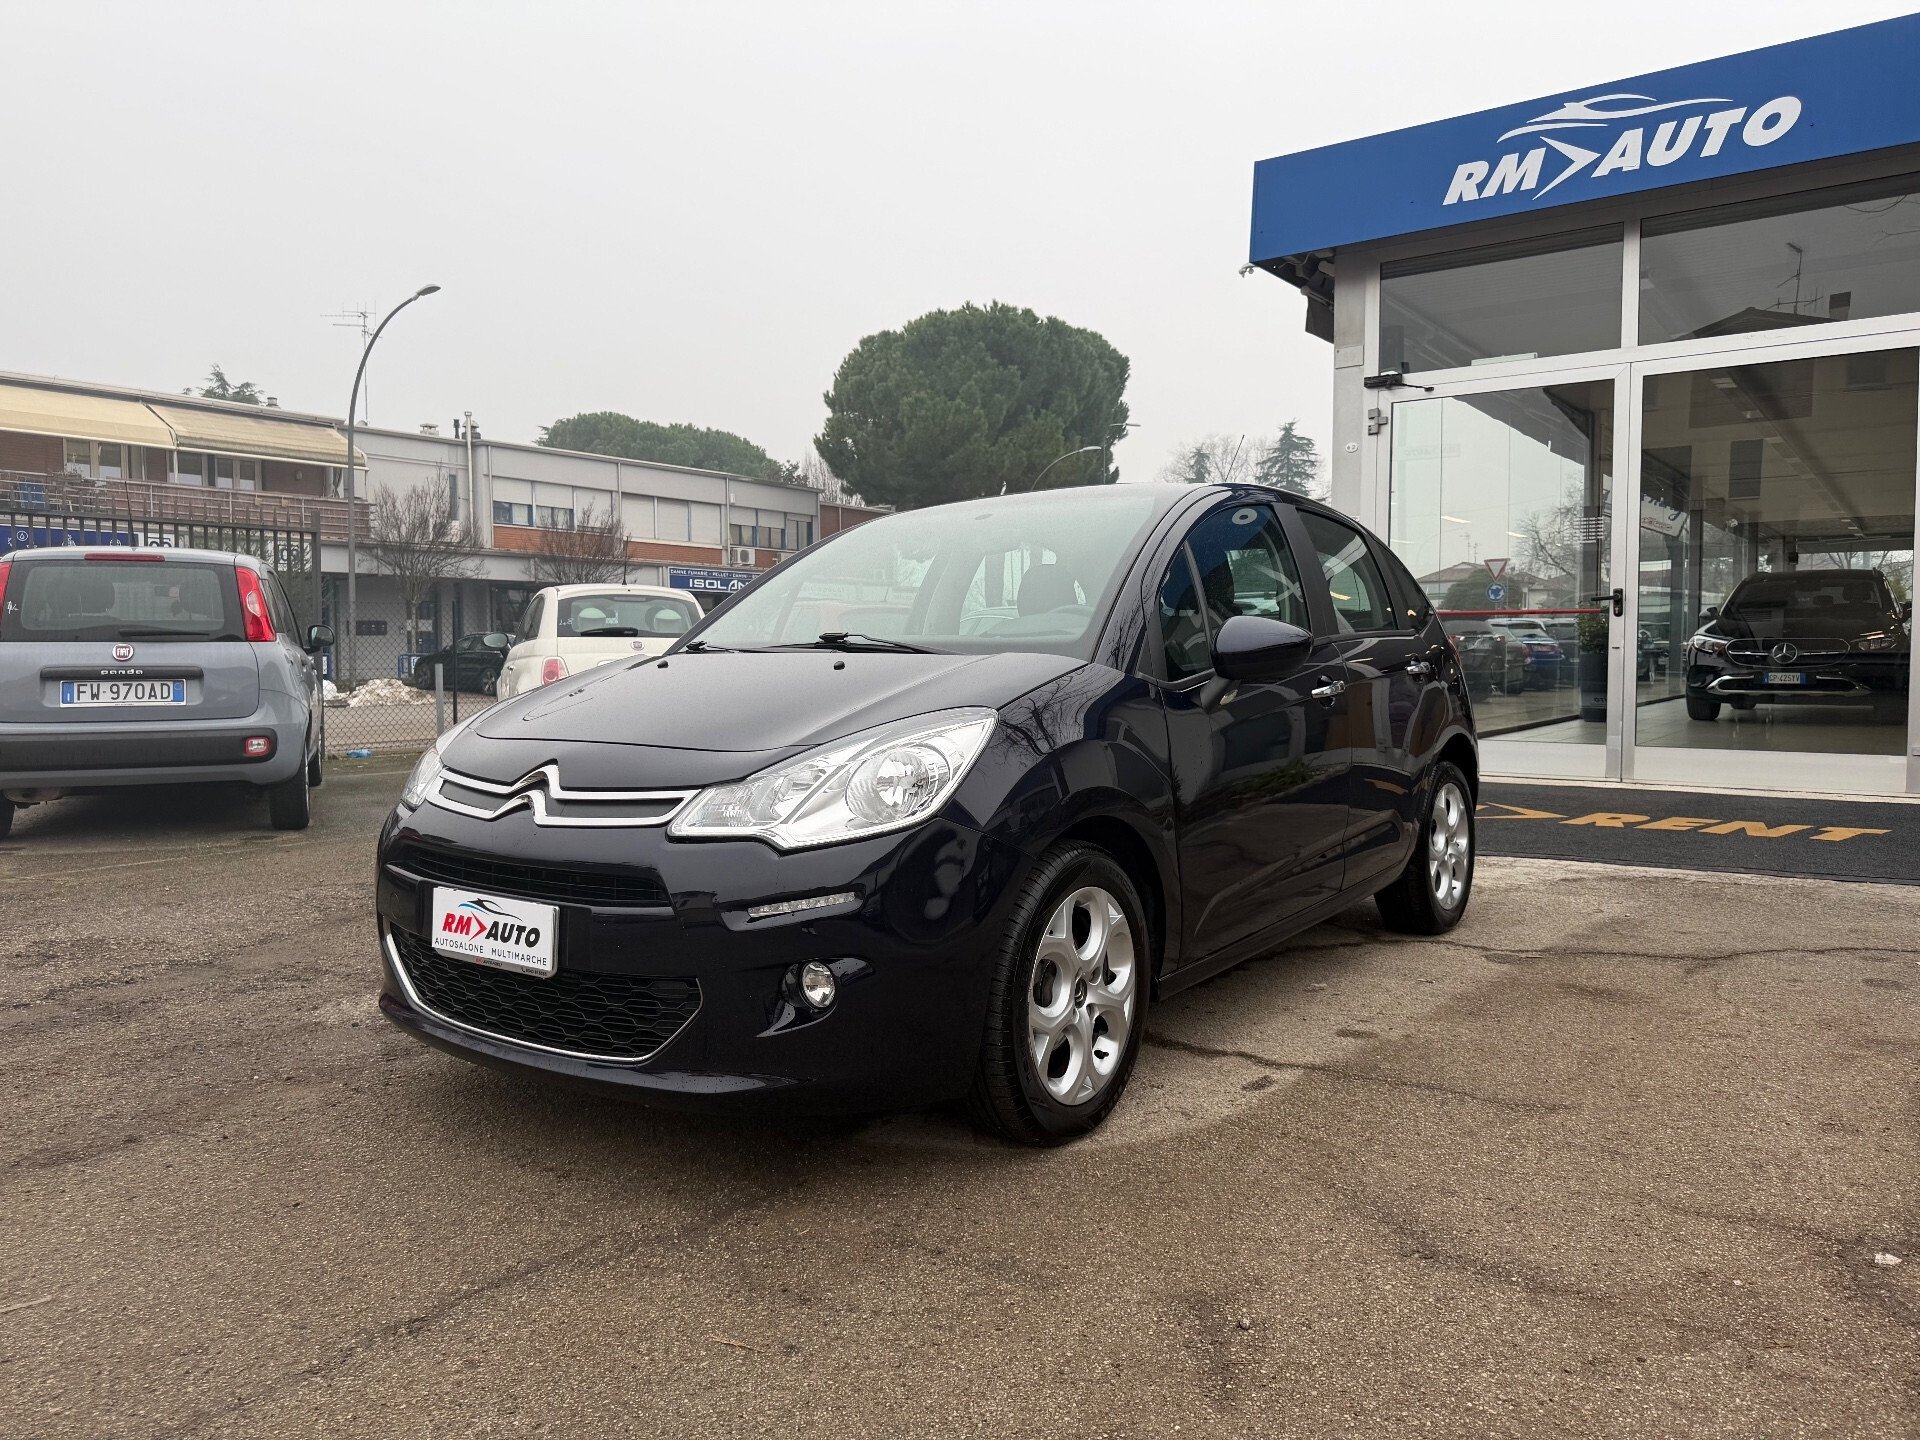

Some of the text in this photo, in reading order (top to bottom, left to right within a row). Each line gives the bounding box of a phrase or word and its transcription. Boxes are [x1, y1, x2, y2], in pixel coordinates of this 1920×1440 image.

[1443, 95, 1802, 206] RM AUTO
[116, 647, 130, 656] FIAT
[100, 668, 144, 676] panda
[1559, 812, 1893, 842] RENT
[442, 912, 541, 948] RM AUTO
[434, 937, 484, 954] AUTOSALONE
[491, 947, 547, 966] MULTIMARCHE
